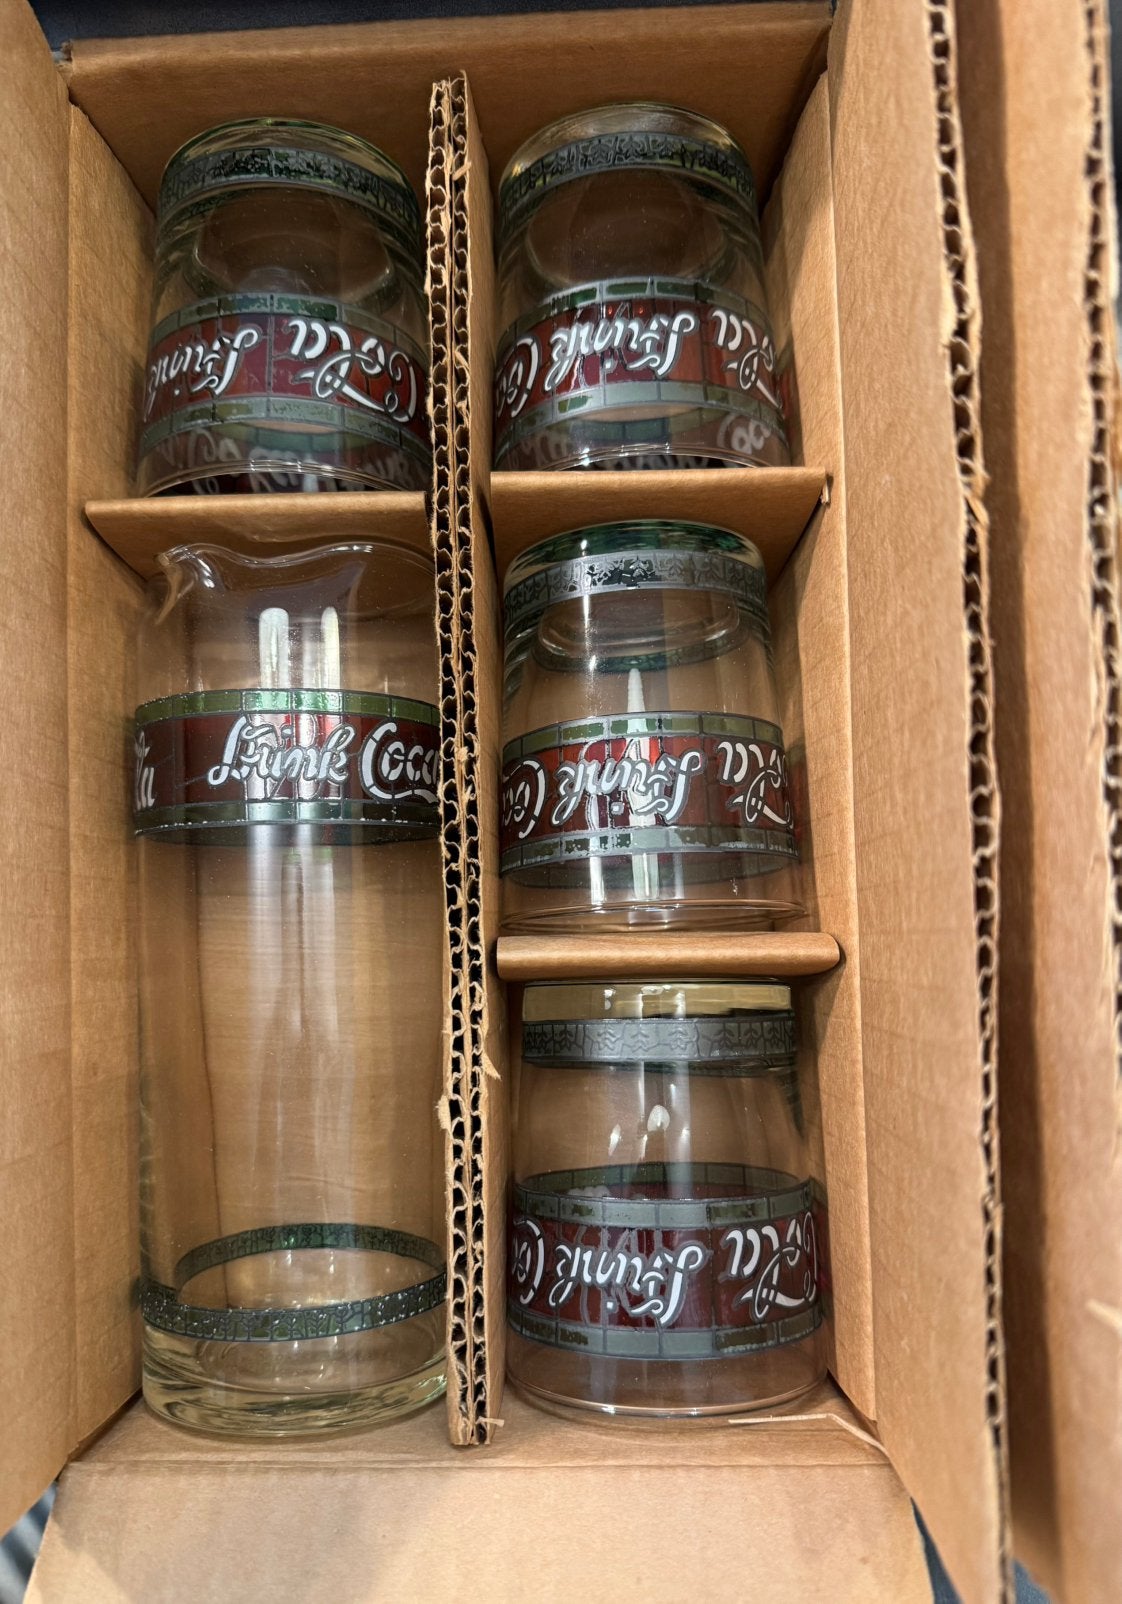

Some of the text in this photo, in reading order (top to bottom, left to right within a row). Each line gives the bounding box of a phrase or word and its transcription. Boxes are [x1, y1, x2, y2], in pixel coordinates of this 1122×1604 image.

[144, 319, 417, 422] Cola Drink
[497, 310, 783, 417] ola Drink Coc
[207, 716, 356, 786] Drink
[552, 751, 702, 825] Drink
[502, 760, 545, 838] Coc
[549, 1245, 703, 1324] Drink
